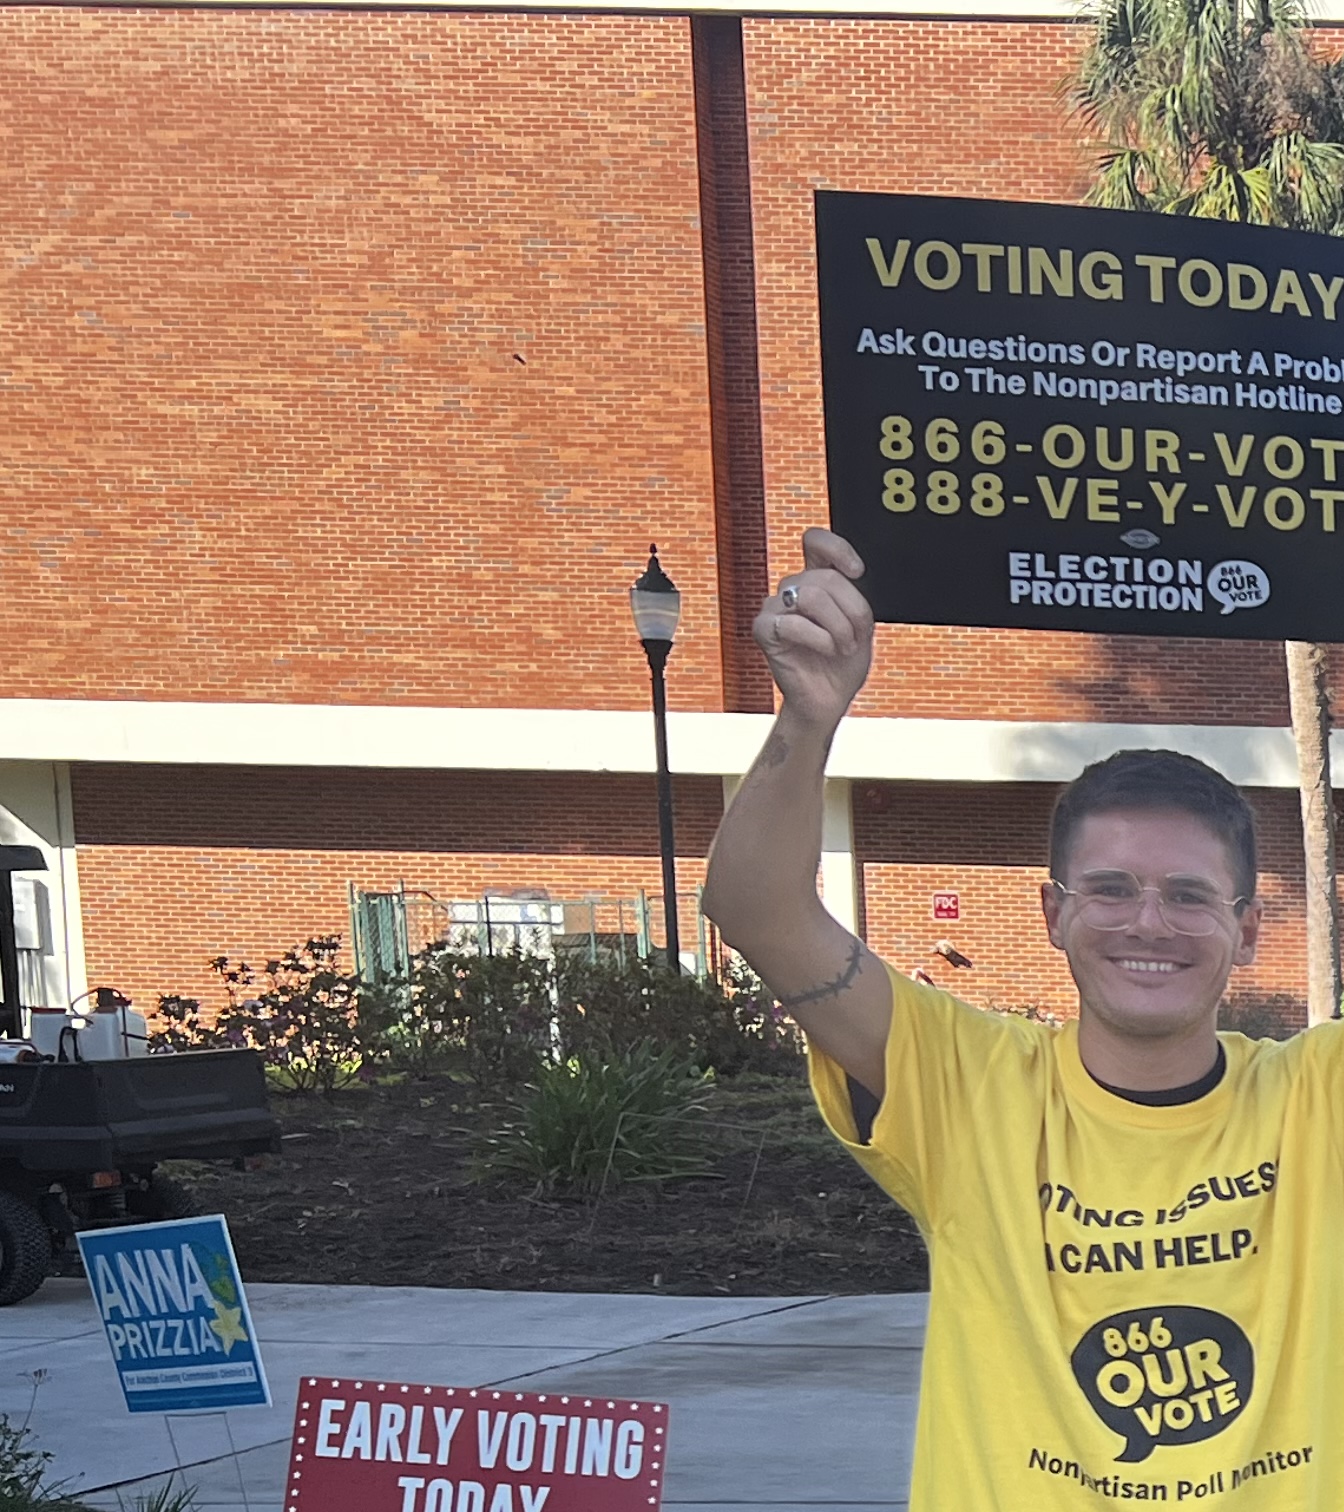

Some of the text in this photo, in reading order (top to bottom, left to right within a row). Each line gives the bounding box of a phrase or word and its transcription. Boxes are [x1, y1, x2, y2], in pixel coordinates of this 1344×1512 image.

[866, 237, 1123, 300] VOTING
[857, 328, 915, 357] Ask
[922, 332, 1085, 367] Questions
[1092, 341, 1130, 369] Or
[1137, 344, 1241, 379] Report
[1247, 351, 1270, 377] A
[918, 364, 1343, 415] To The Nonpartisan Hotline
[1009, 552, 1202, 585] ELECTION
[1218, 574, 1259, 592] OUR
[1010, 581, 1203, 612] PROTECTION
[1229, 589, 1263, 603] VOTE
[1038, 1182, 1145, 1228] OTING
[1060, 1240, 1144, 1274] CAN
[1154, 1228, 1259, 1269] HELP.
[93, 1243, 215, 1320] ANNA
[107, 1316, 222, 1361] PRIZZIA
[1103, 1316, 1172, 1358] 866
[1095, 1338, 1231, 1408] OUR
[1134, 1380, 1241, 1437] VOTE
[314, 1398, 645, 1480] EARLY VOTING
[1176, 1472, 1224, 1501] Poll
